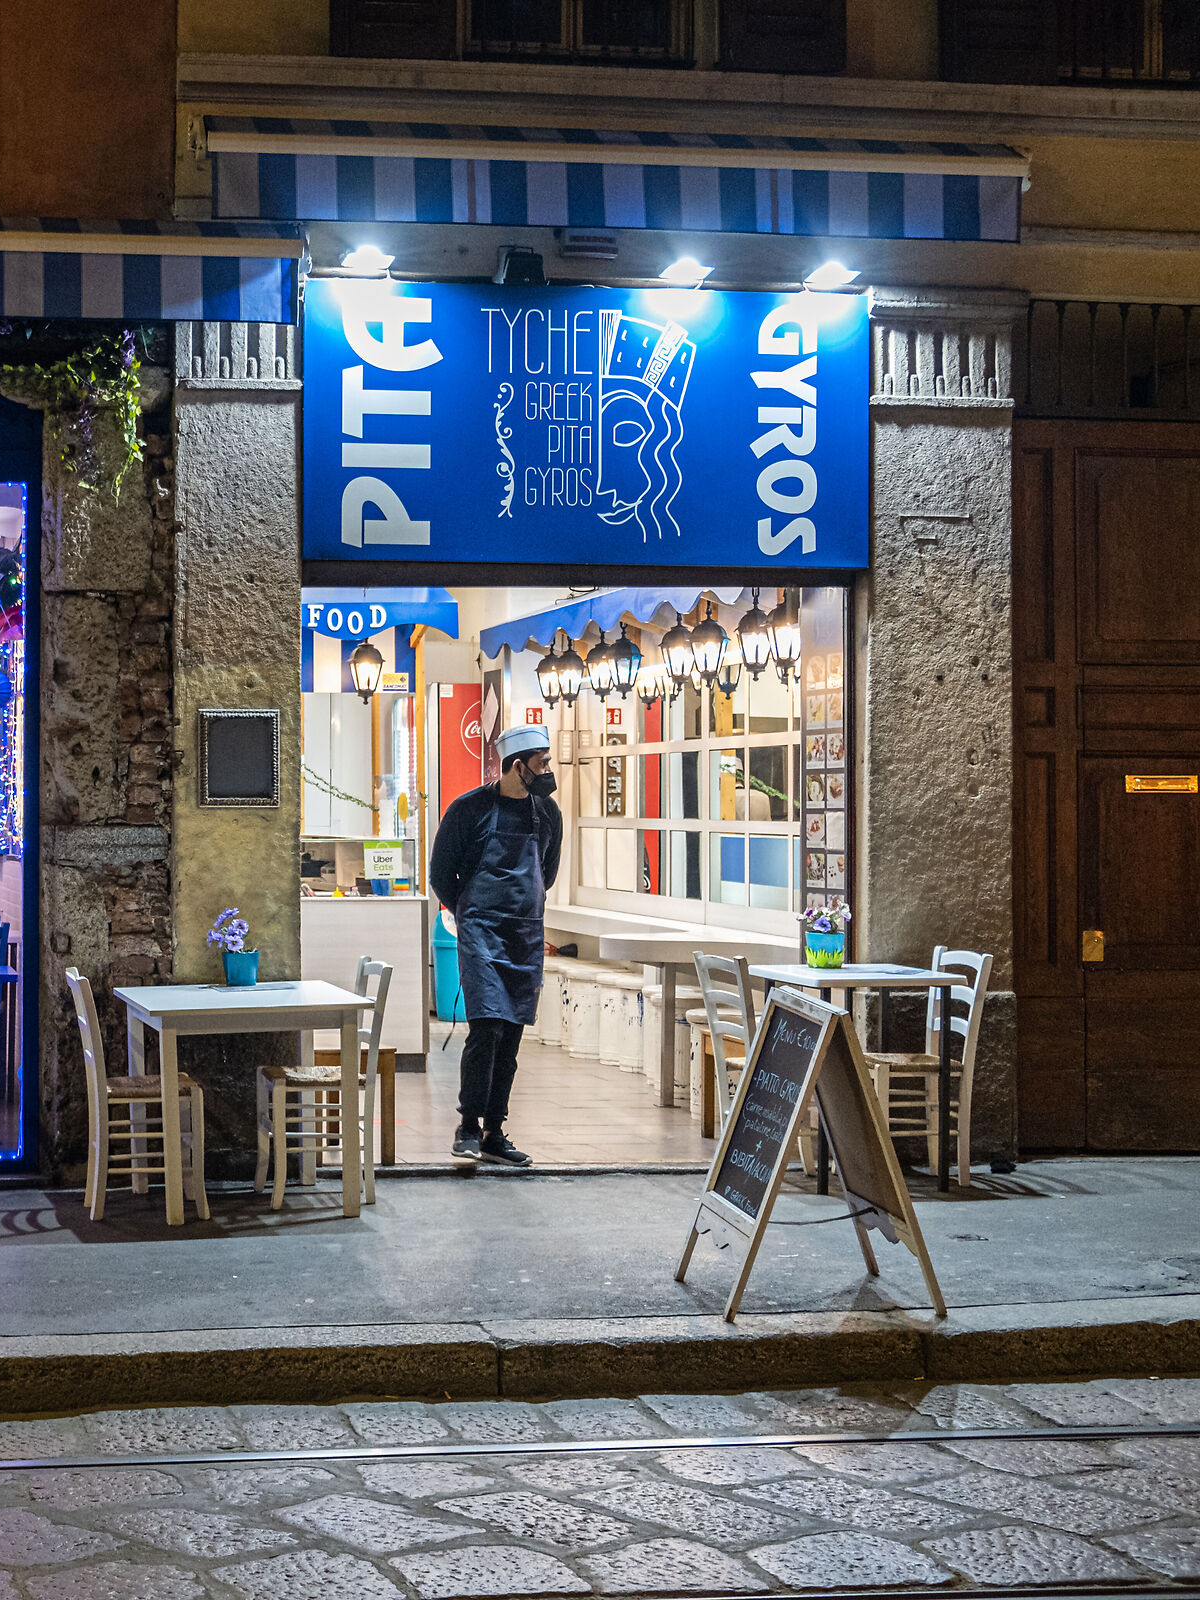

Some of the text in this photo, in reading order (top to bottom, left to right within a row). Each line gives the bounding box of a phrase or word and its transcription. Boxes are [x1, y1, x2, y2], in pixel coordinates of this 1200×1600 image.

[481, 308, 594, 375] TYCHE
[525, 381, 593, 421] GREEK
[341, 296, 444, 548] PITA
[750, 299, 818, 556] GYROS
[548, 425, 592, 464] PITA
[524, 467, 593, 506] GYROS
[307, 604, 387, 635] FOOD
[373, 855, 393, 863] Uber
